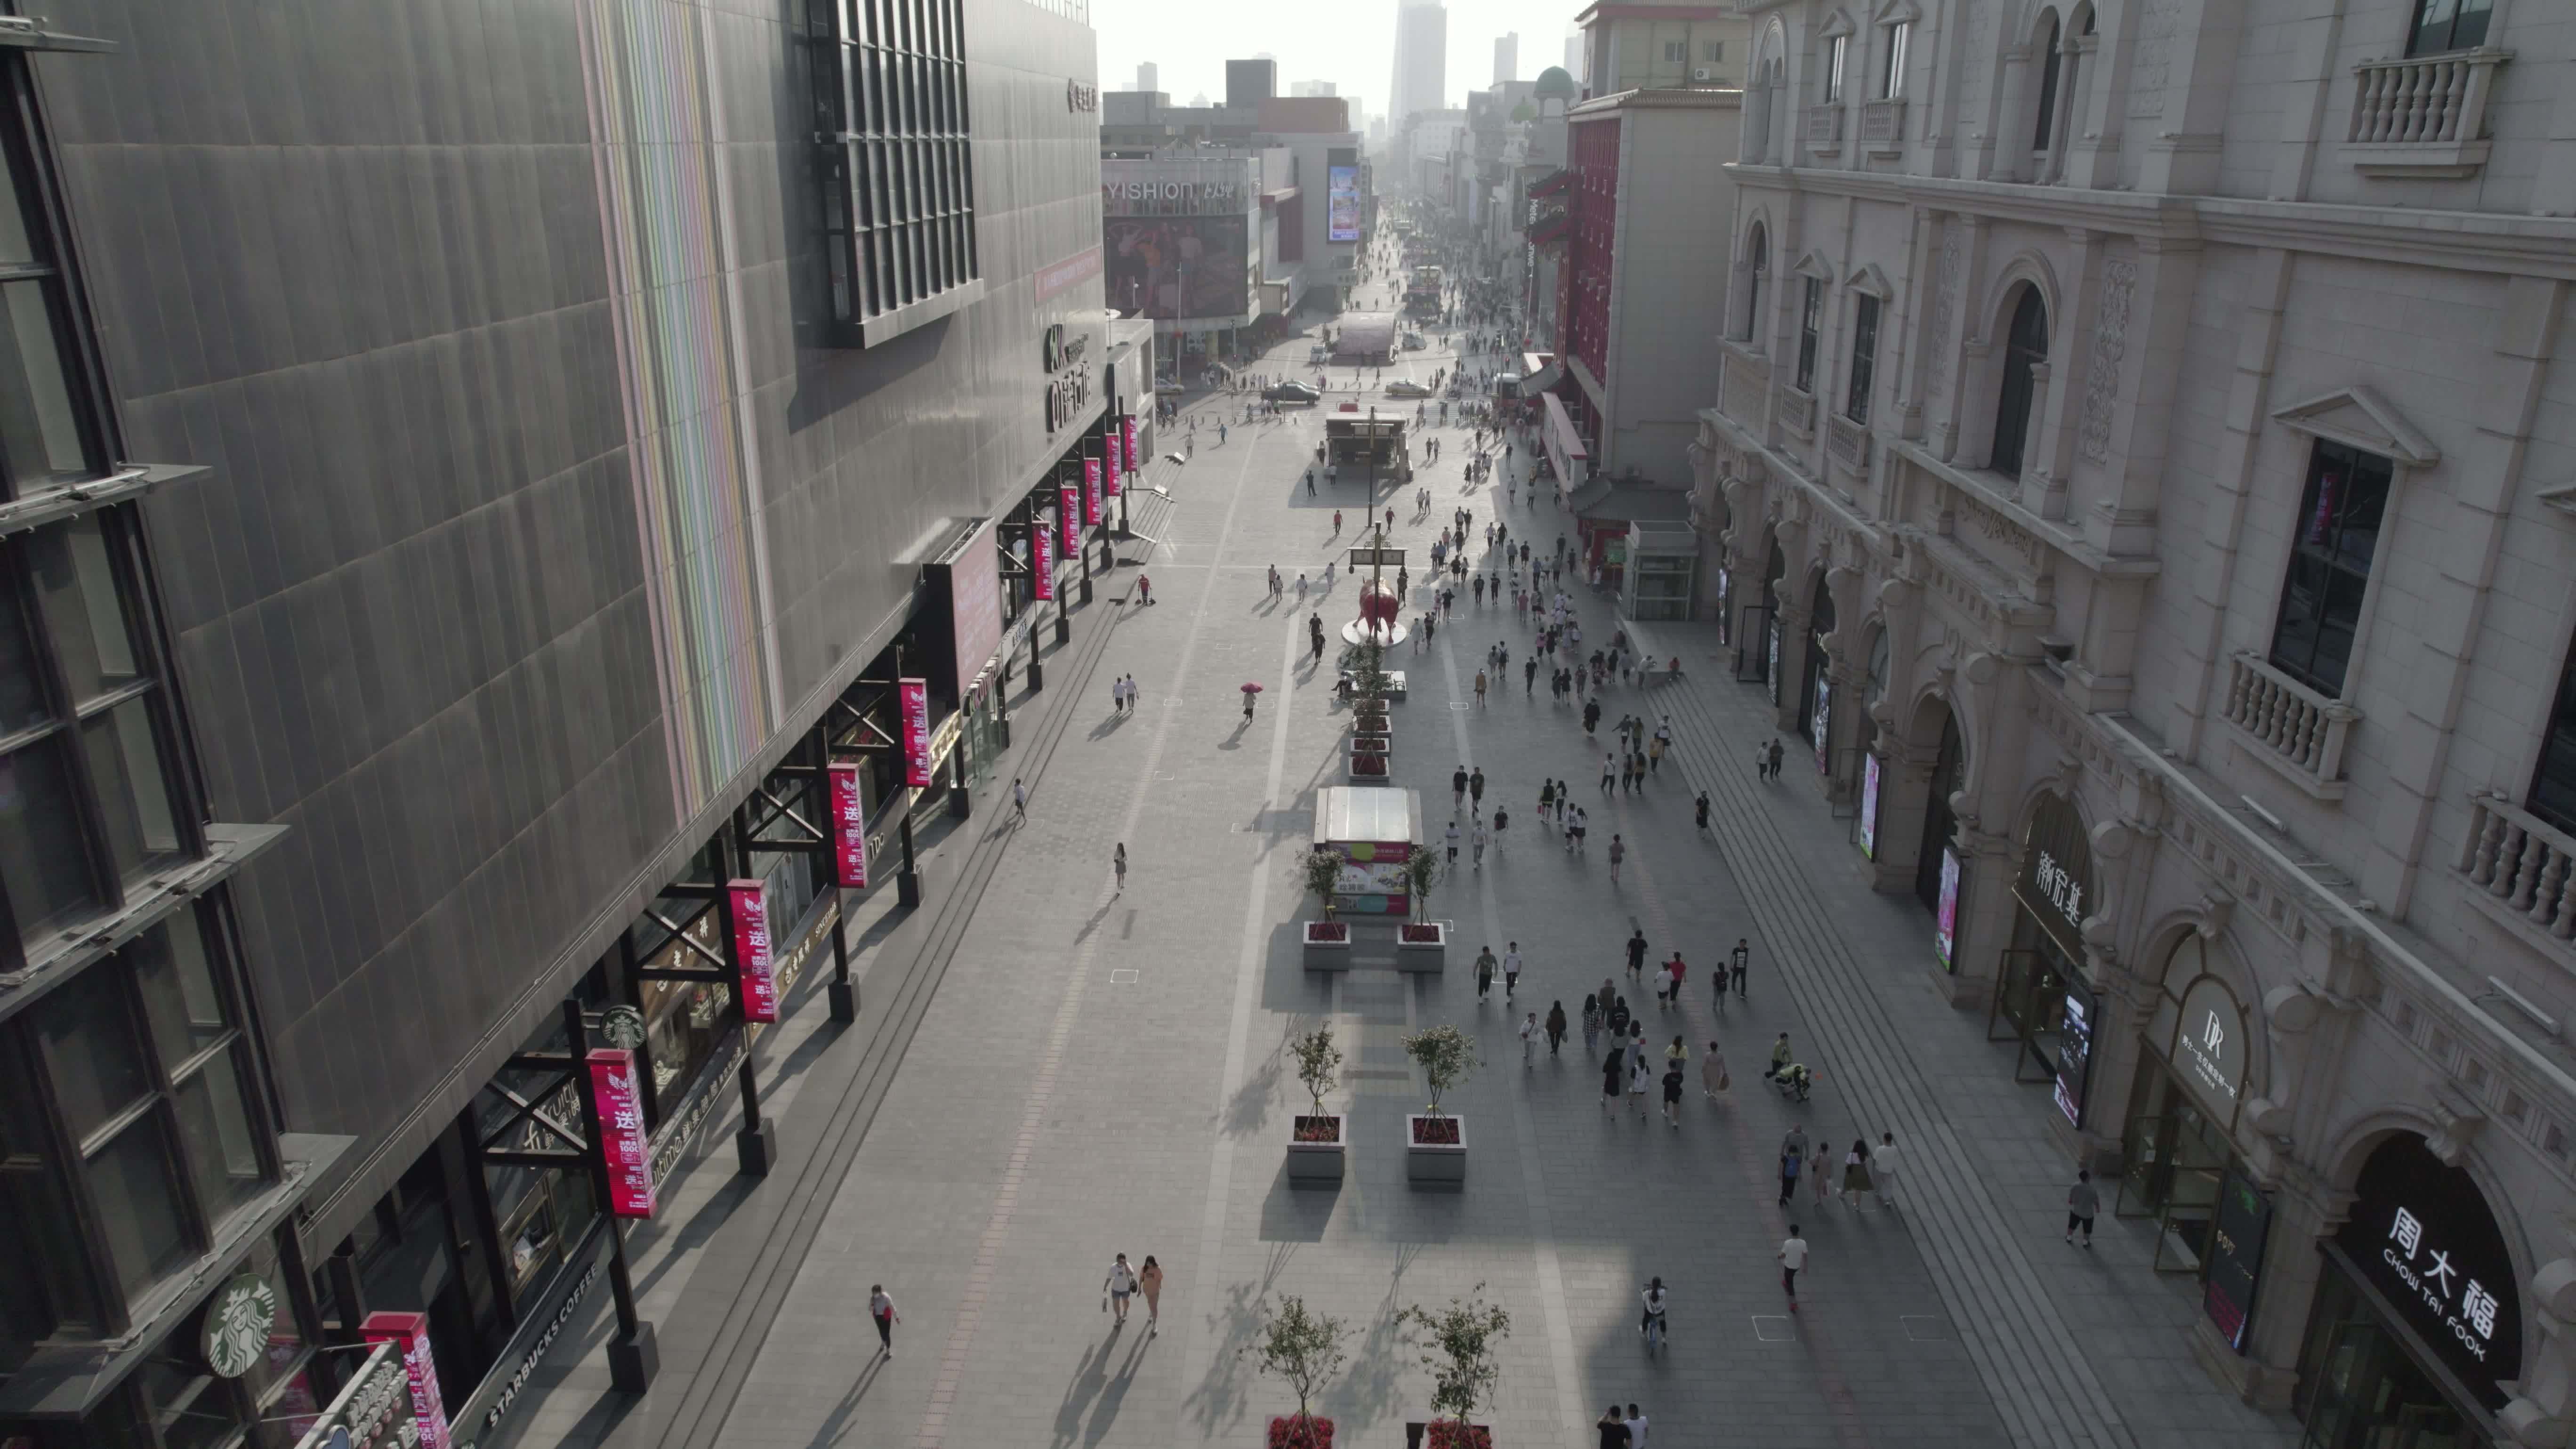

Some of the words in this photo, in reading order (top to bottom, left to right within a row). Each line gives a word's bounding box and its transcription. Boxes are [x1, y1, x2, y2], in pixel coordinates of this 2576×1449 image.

[2384, 1248, 2421, 1291] CHOW
[2423, 1286, 2444, 1316] TAI
[2447, 1316, 2486, 1362] FOOK
[2389, 1206, 2498, 1340] 周大福
[489, 1319, 559, 1428] STARBUCKS
[559, 1261, 597, 1325] COFFEE
